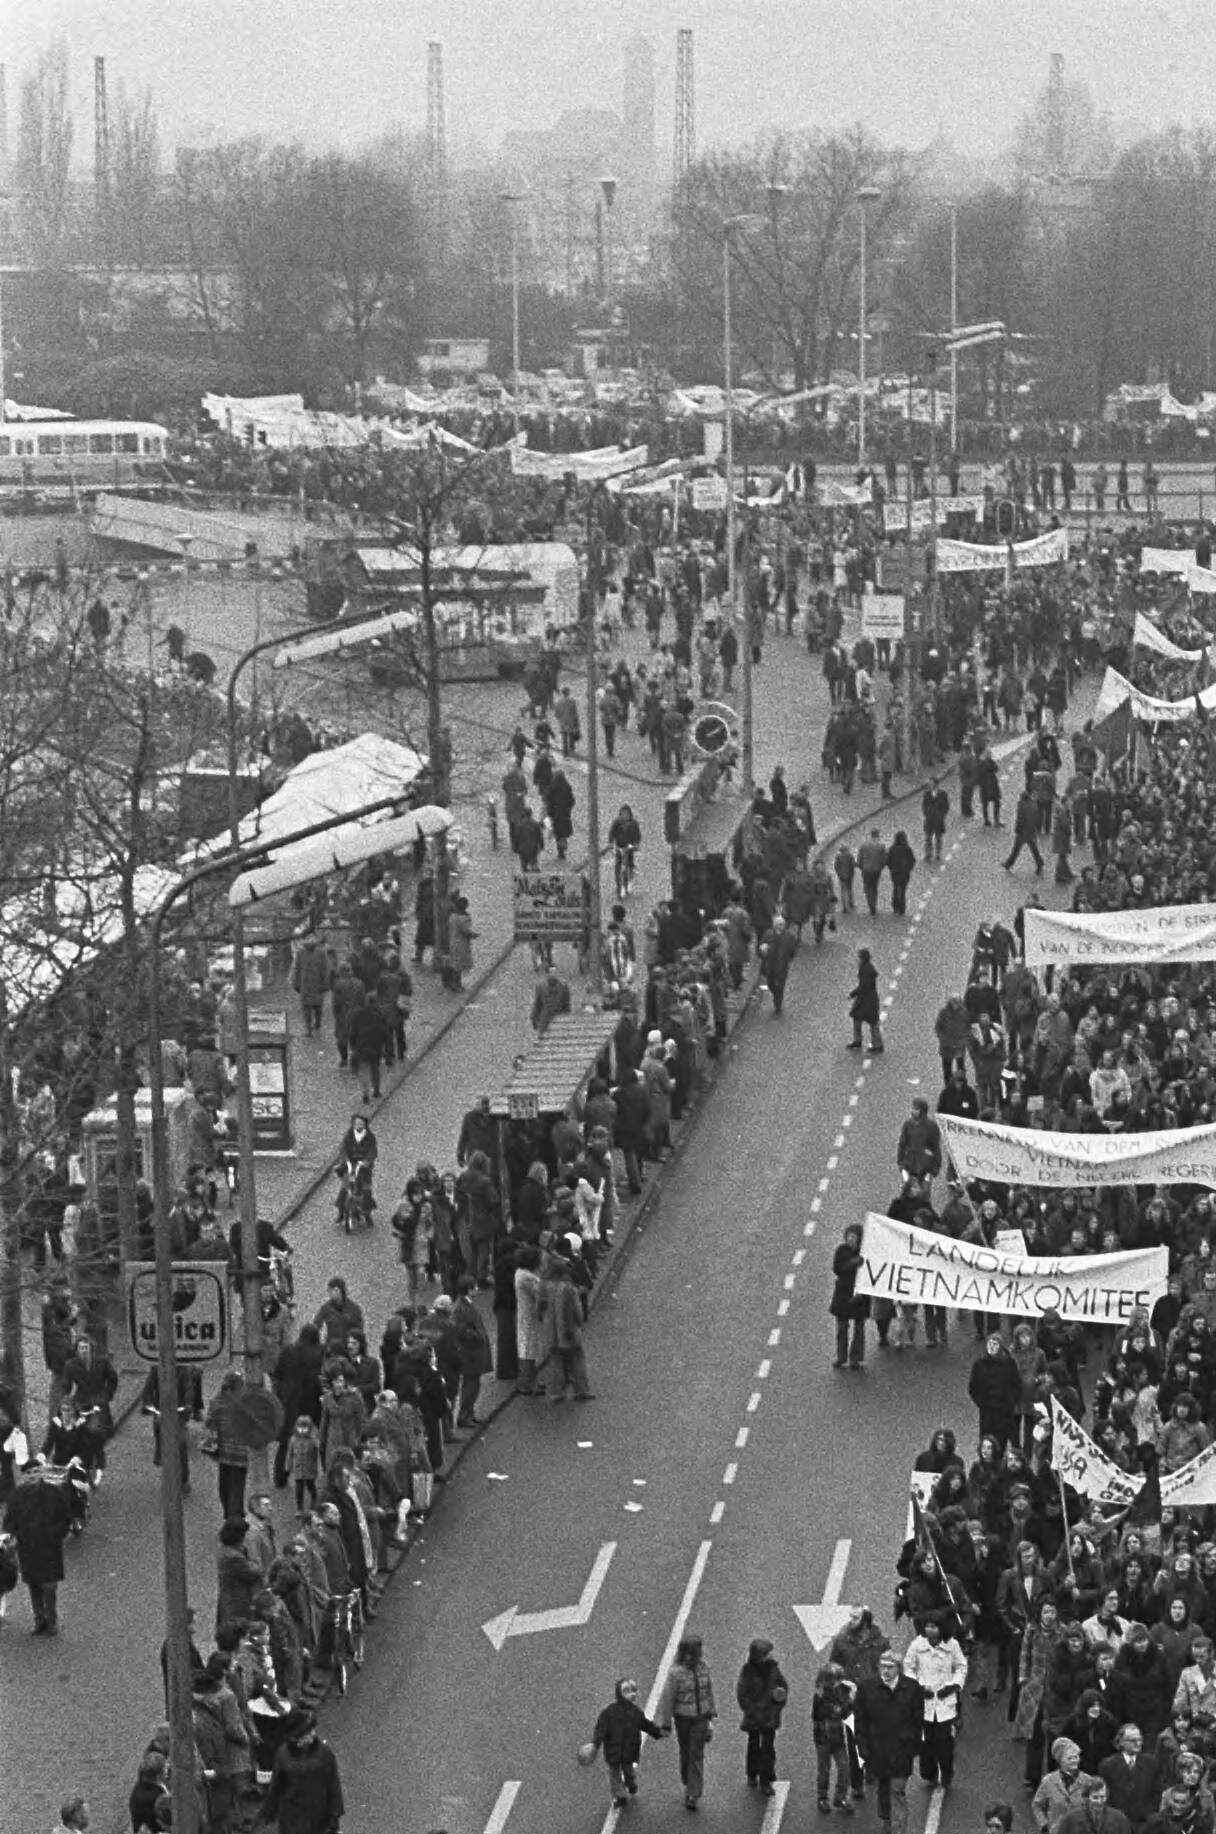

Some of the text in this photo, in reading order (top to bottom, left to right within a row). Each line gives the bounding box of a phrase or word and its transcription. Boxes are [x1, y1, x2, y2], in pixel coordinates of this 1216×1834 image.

[1049, 1138, 1091, 1154] VAN
[863, 1258, 1152, 1319] VIETNAMKOMITEE
[140, 1315, 216, 1341] uica
